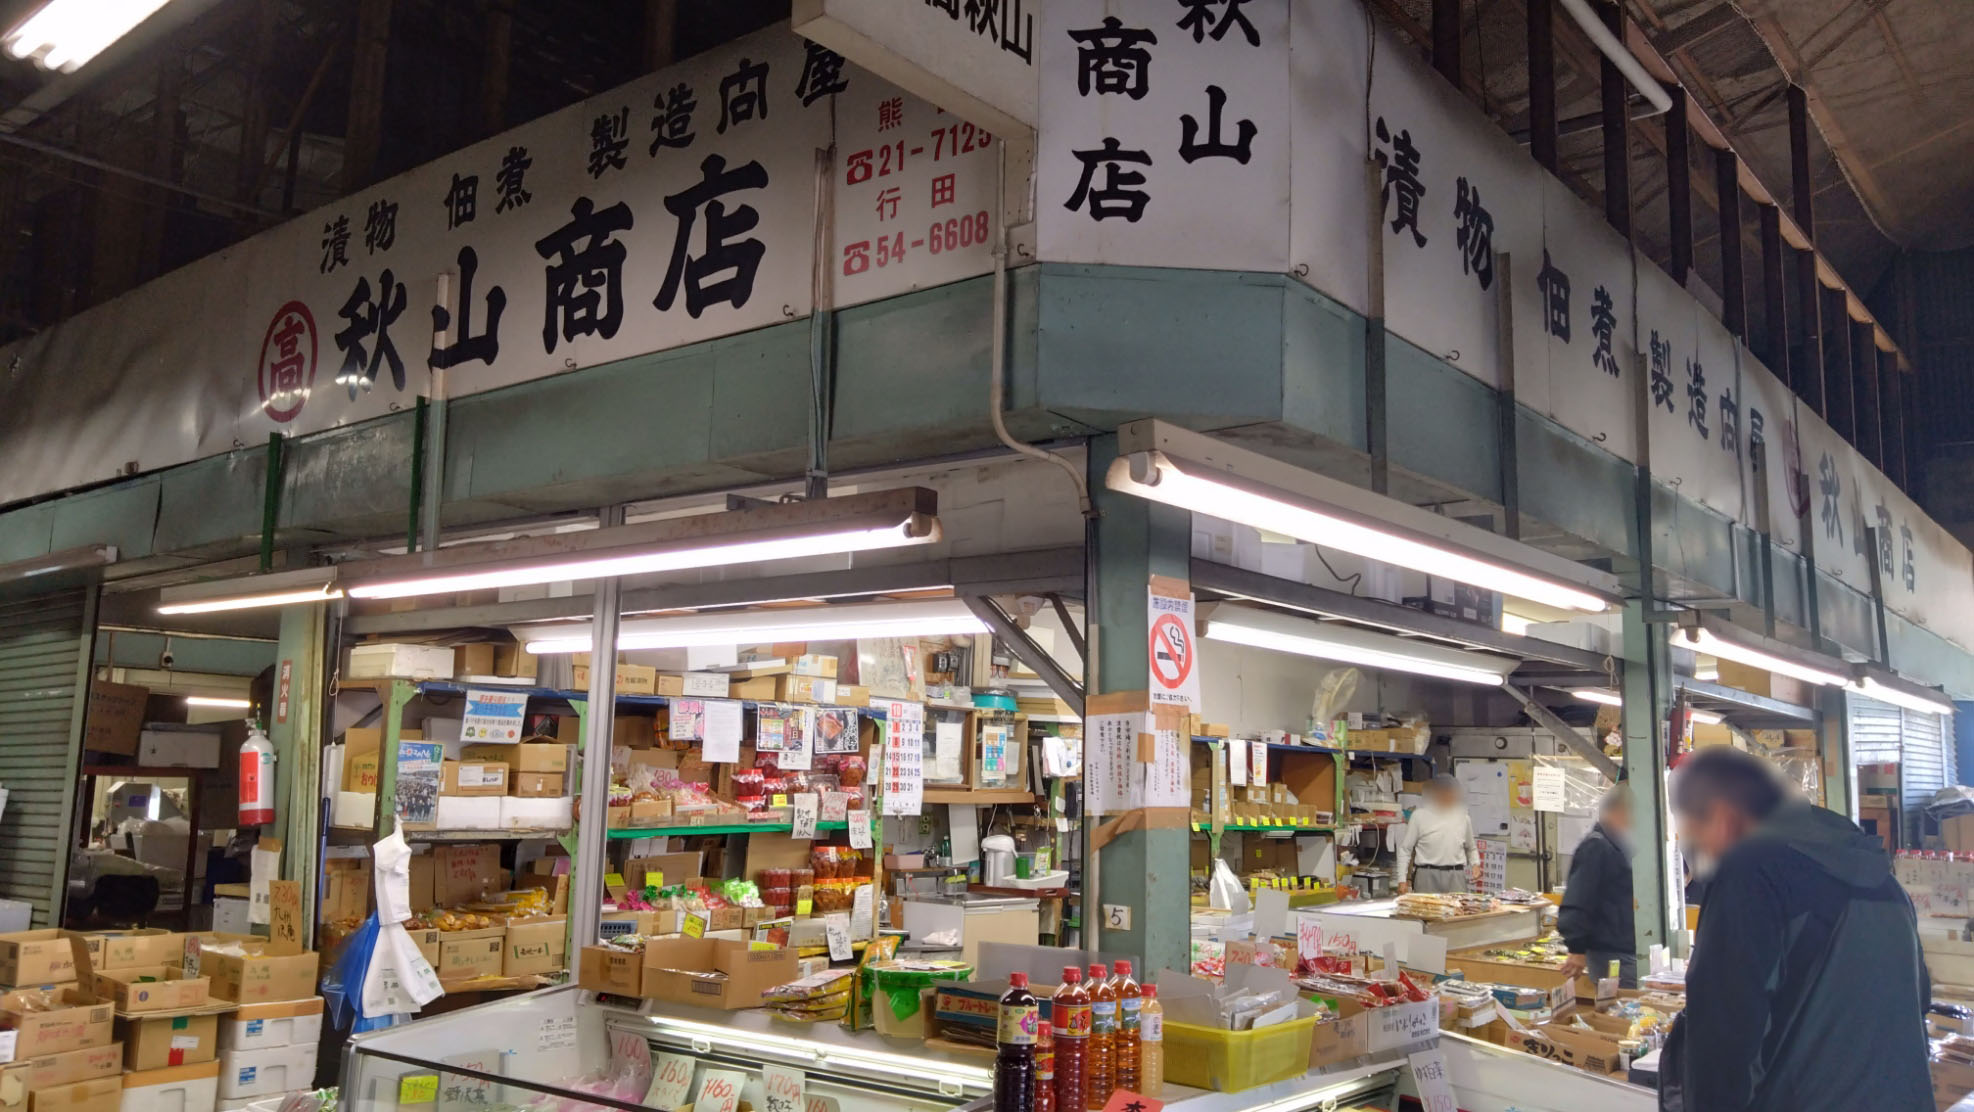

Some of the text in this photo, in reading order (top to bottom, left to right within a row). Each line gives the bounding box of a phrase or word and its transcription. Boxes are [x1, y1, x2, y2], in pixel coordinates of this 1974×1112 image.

[1063, 16, 1157, 222] 商店
[320, 200, 399, 274] 漬物
[444, 147, 533, 231] 佃煮
[876, 173, 956, 222] 行田
[877, 210, 989, 268] 54-6608
[1375, 116, 1494, 291] 漬物
[1537, 248, 1620, 378] 佃煮
[334, 153, 769, 401] 秋山商店
[1110, 907, 1123, 926] 5
